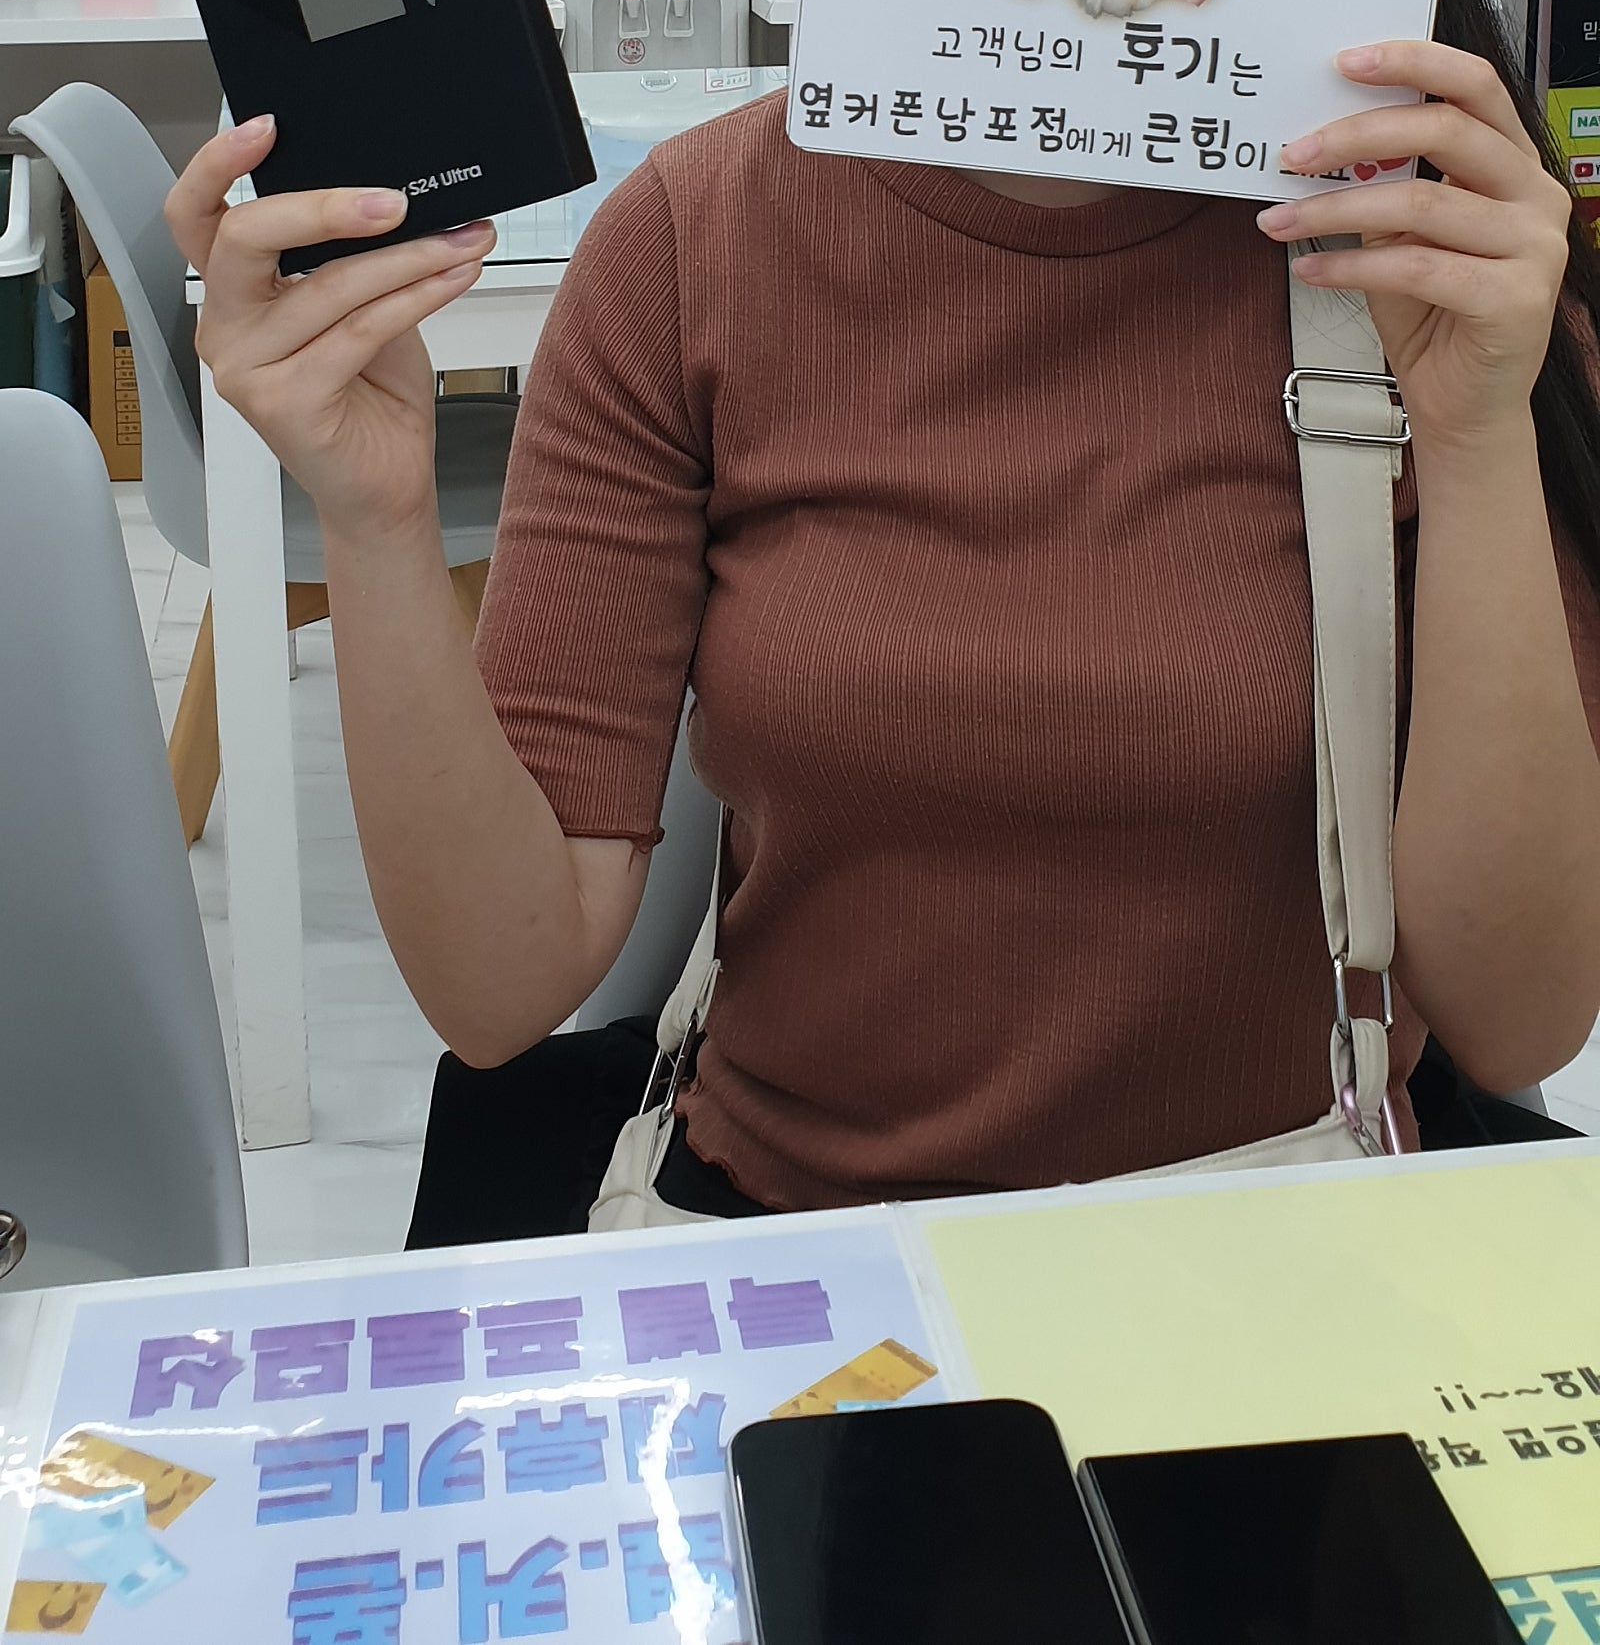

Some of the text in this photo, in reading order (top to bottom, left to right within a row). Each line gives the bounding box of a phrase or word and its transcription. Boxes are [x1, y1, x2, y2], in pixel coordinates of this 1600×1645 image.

[1583, 20, 1600, 41] 믿
[933, 22, 1262, 96] 고객님의 후기는
[1577, 116, 1600, 128] NA
[409, 165, 482, 196] S24 Ultra
[128, 1294, 584, 1419] 프로모션
